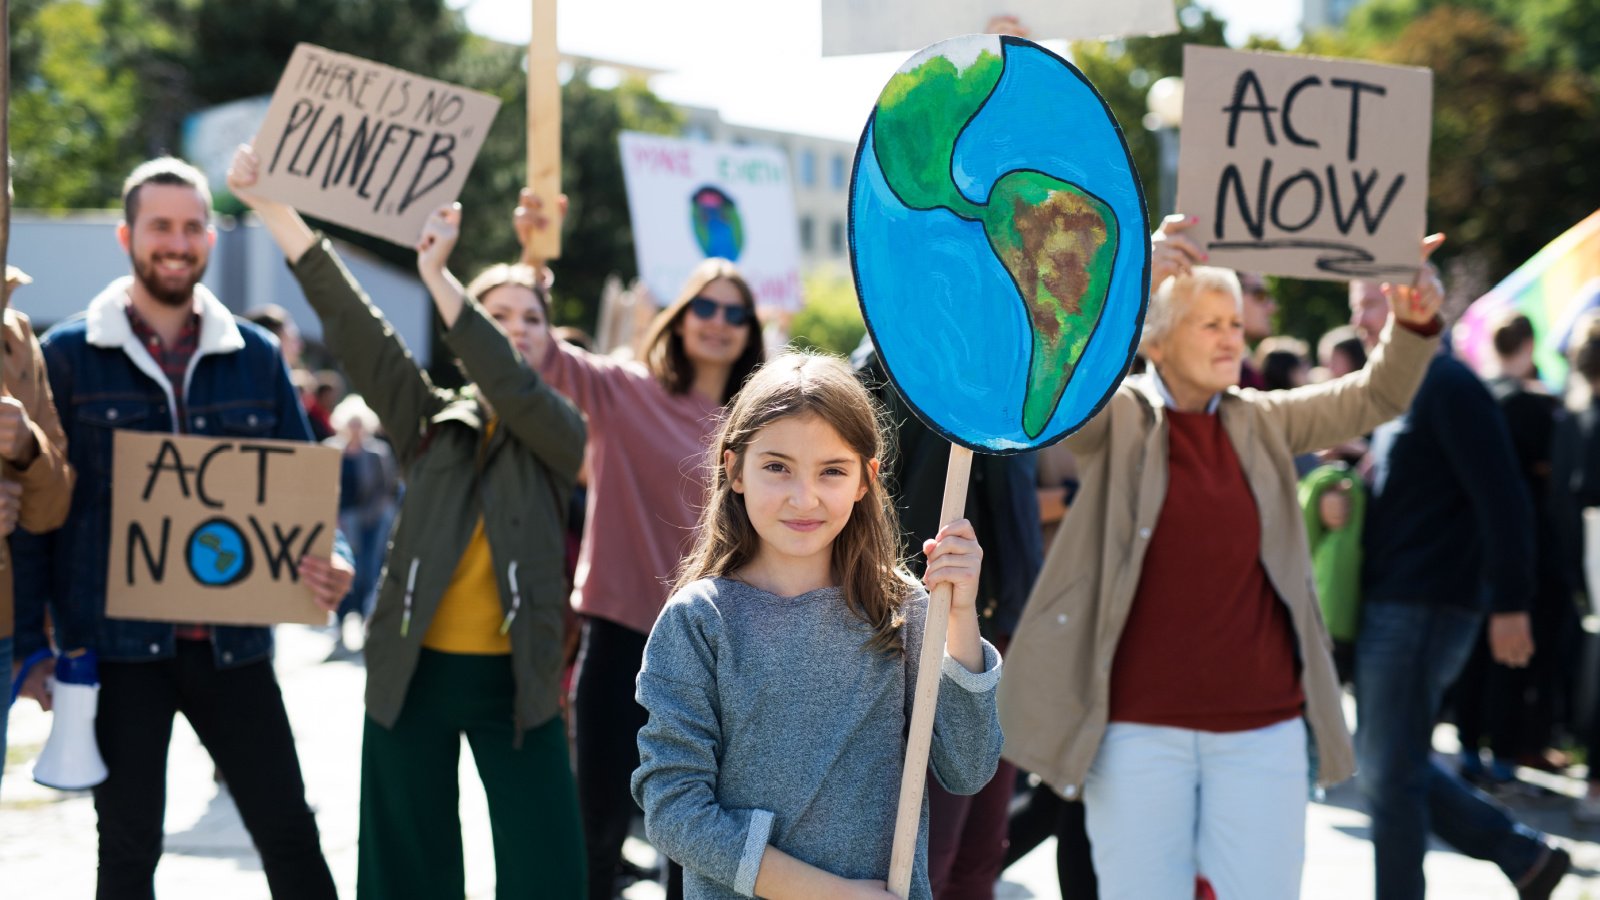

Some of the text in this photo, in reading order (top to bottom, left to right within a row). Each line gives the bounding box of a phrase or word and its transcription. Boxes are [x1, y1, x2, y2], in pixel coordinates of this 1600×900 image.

[294, 53, 465, 127] THERE IS NO
[1222, 69, 1387, 162] ACT
[267, 97, 424, 213] PLANET
[1214, 158, 1406, 239] NOW
[141, 439, 296, 509] ACT
[126, 514, 325, 590] NOW
